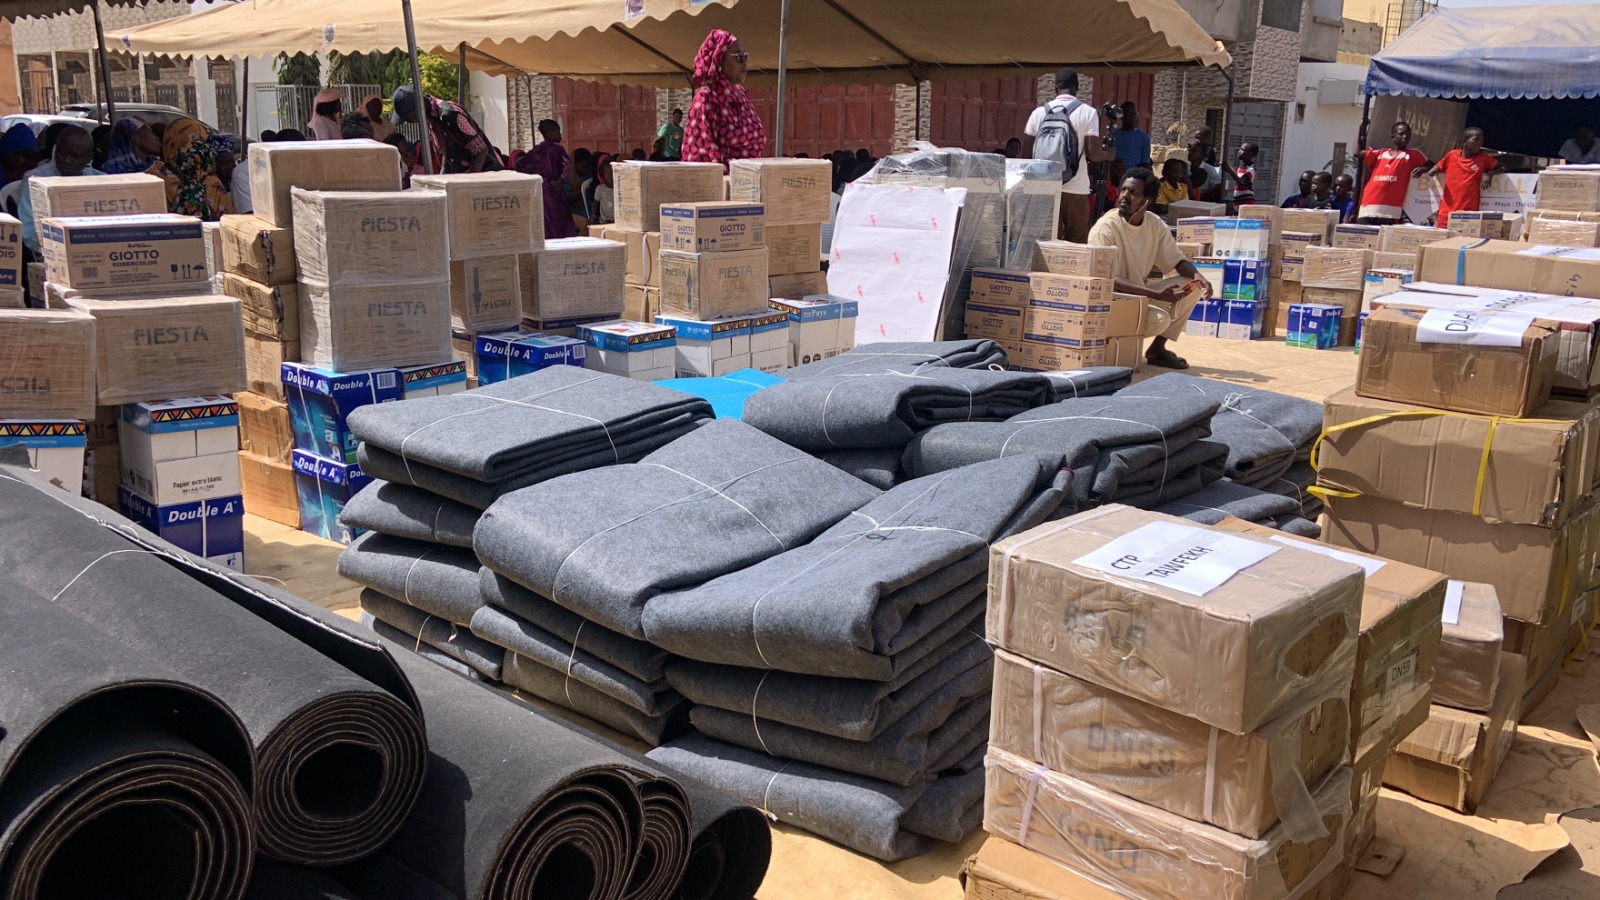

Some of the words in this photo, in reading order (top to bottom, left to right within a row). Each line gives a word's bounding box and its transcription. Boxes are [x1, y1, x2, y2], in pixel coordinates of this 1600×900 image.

[781, 176, 816, 189] FIESTA
[84, 198, 142, 213] FIESTA
[472, 196, 521, 212] FIESTA
[361, 216, 421, 233] FIESTA
[719, 224, 746, 232] GIOTTO
[109, 249, 160, 261] GIOTTO
[563, 261, 607, 276] FIESTA
[718, 265, 752, 279] FIESTA
[989, 284, 1013, 293] GIOTTO
[1046, 289, 1069, 297] GIOTTO
[367, 300, 427, 317] FIESTA
[811, 309, 827, 319] Pays
[982, 317, 1004, 326] GIOTTO
[1041, 324, 1064, 333] GIOTTO
[134, 324, 209, 346] FIESTA
[484, 342, 519, 357] Double
[522, 350, 530, 359] A
[544, 350, 564, 360] Double
[1038, 358, 1062, 367] GIOTTO
[286, 371, 314, 388] Double
[333, 376, 364, 391] Double
[298, 457, 327, 475] Double
[329, 468, 336, 478] A
[172, 481, 190, 489] Papier
[191, 478, 207, 486] extra
[207, 476, 223, 484] blanc
[168, 505, 219, 523] Double
[223, 501, 234, 514] A
[1110, 554, 1142, 570] CTP
[1146, 545, 1214, 578] TAWFEKH
[1391, 659, 1411, 682] DN59
